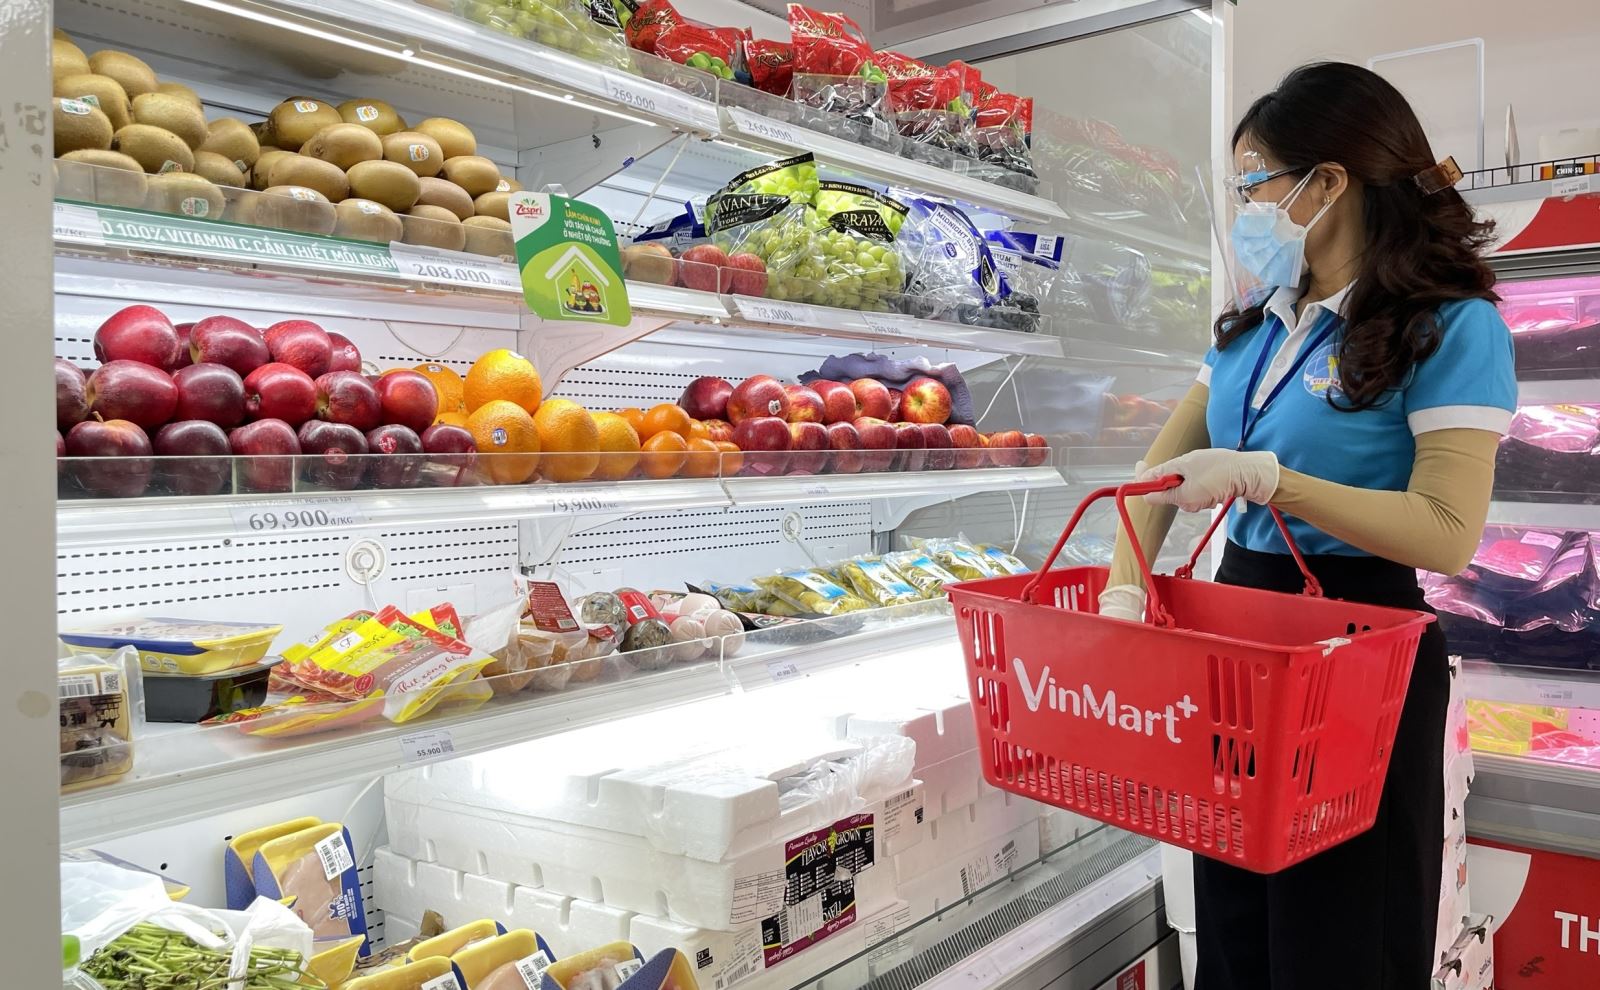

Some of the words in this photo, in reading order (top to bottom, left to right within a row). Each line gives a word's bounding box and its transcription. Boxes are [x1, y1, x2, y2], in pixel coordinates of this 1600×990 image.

[515, 203, 544, 216] Zespri
[937, 211, 969, 239] MIDNIGHT
[116, 222, 165, 242] 100%
[165, 228, 237, 250] VITAMIN
[238, 238, 251, 251] C
[252, 236, 287, 256] CẦN
[288, 243, 331, 261] THIẾT
[334, 244, 358, 264] MỖI
[358, 250, 399, 270] NGÀY
[413, 263, 491, 284] 208.000
[250, 509, 329, 531] 69,900
[416, 747, 441, 757] 55.900
[801, 839, 828, 867] FLAVOR
[836, 827, 862, 846] GROWN
[823, 901, 842, 922] FLAVO
